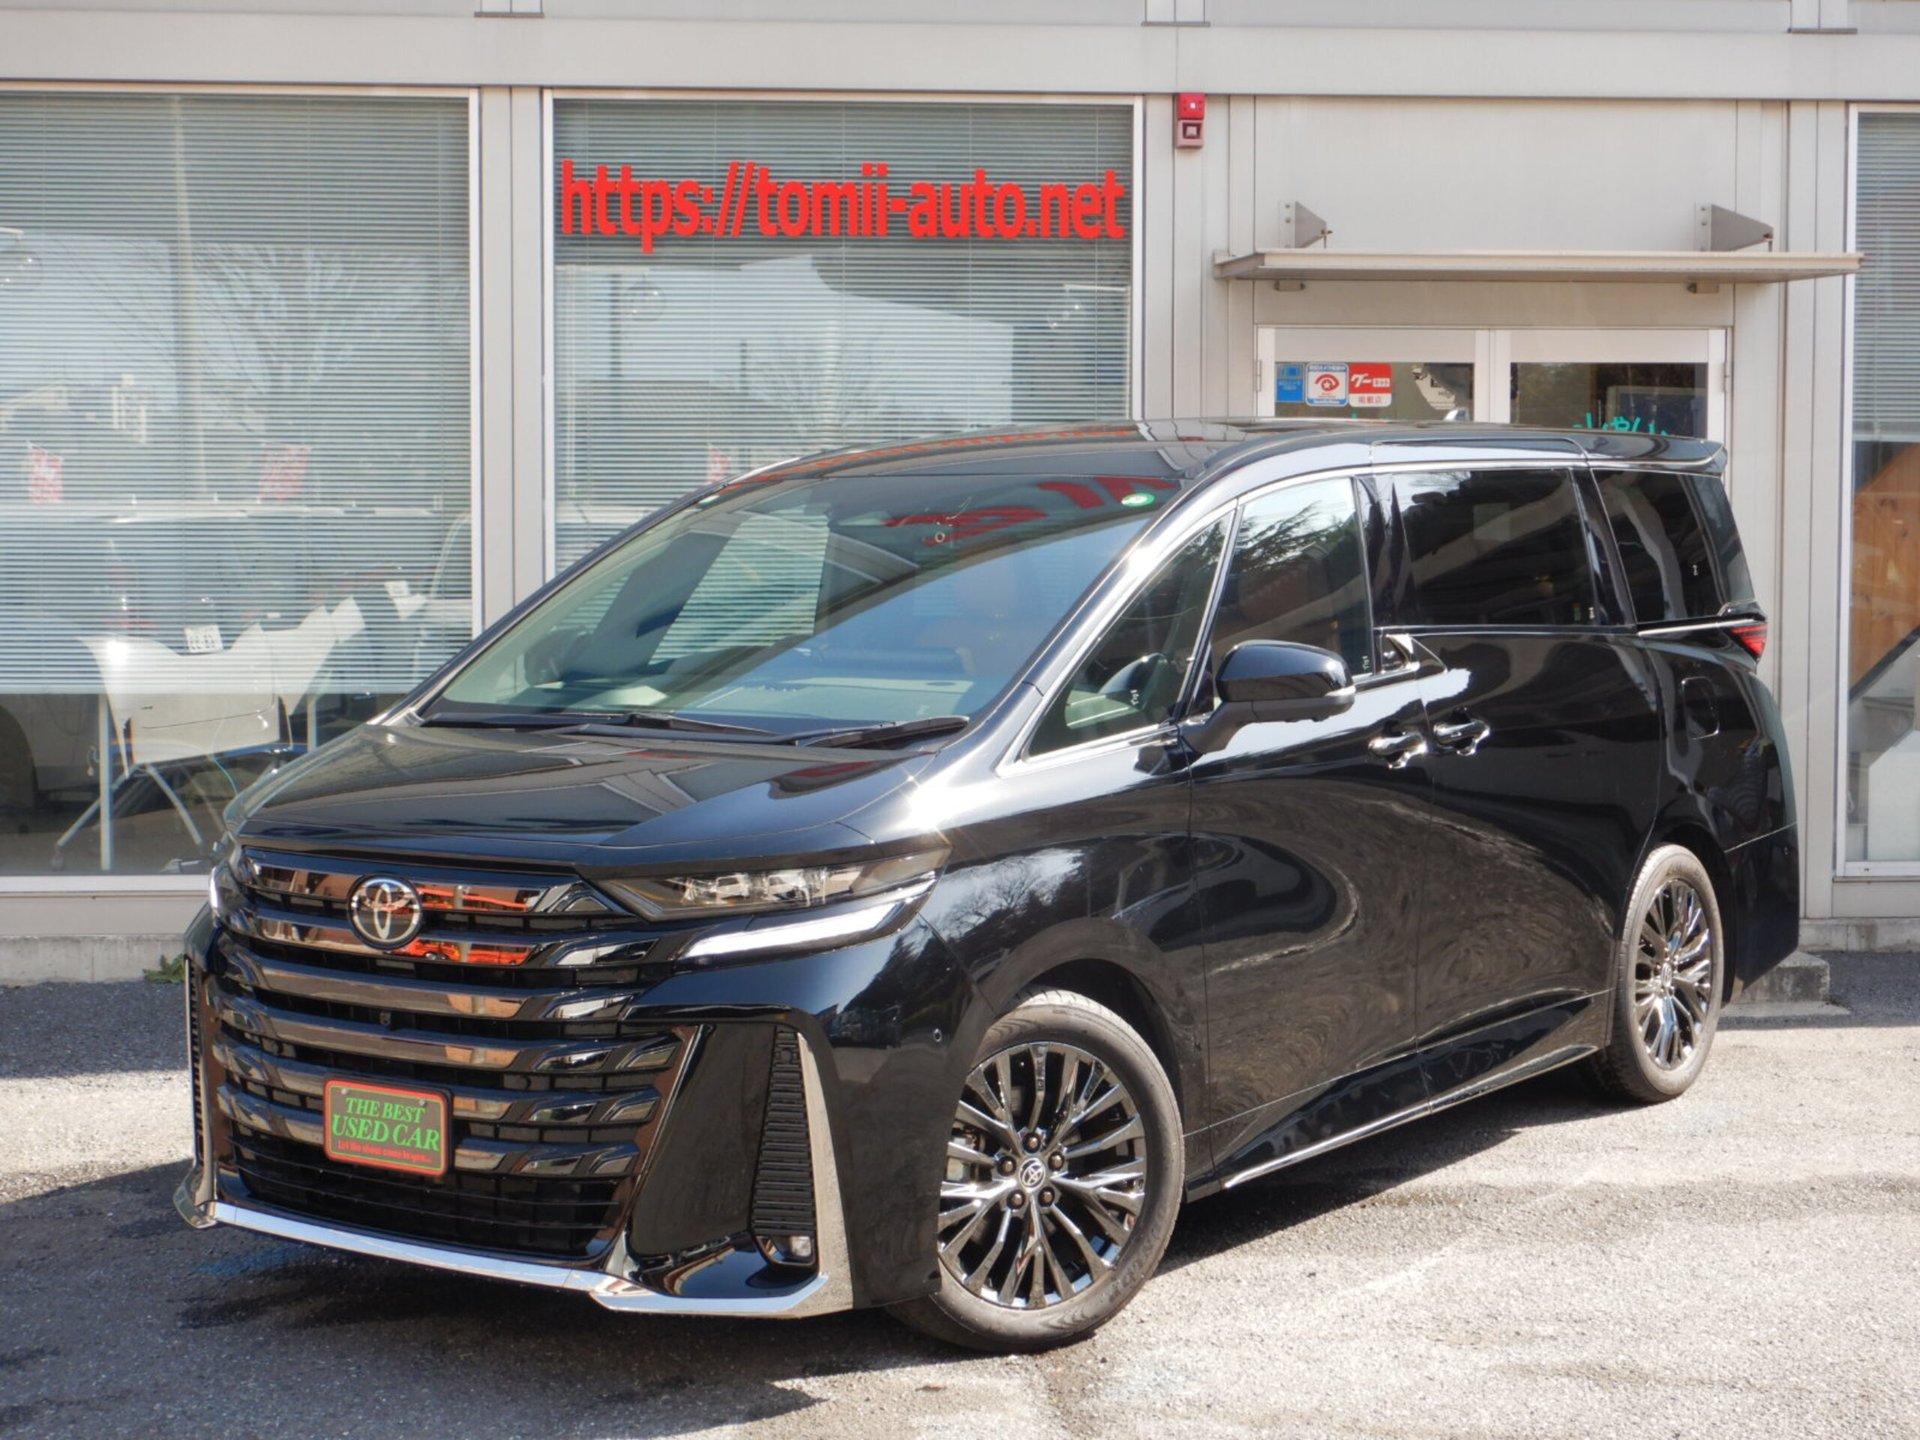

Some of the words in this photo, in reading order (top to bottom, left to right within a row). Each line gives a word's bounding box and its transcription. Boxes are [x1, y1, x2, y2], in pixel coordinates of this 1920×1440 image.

[561, 160, 1125, 254] https://tomii-auto.net
[345, 1097, 380, 1117] THE
[382, 1102, 425, 1123] BEST
[332, 1114, 389, 1142] USED
[392, 1123, 440, 1151] CAR
